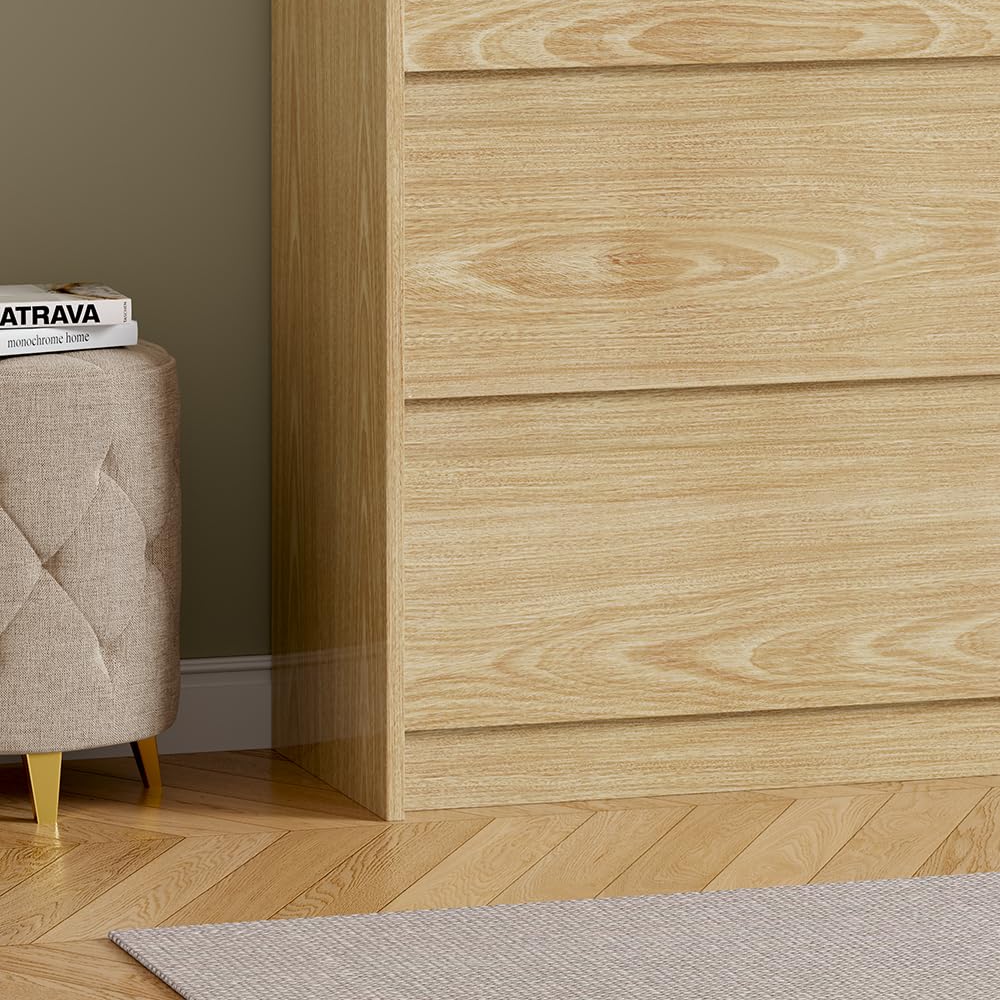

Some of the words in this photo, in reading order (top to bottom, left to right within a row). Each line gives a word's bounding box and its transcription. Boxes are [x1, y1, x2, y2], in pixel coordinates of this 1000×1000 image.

[0, 303, 100, 327] ATRAVA
[7, 334, 63, 348] monochrome
[65, 332, 90, 343] home
